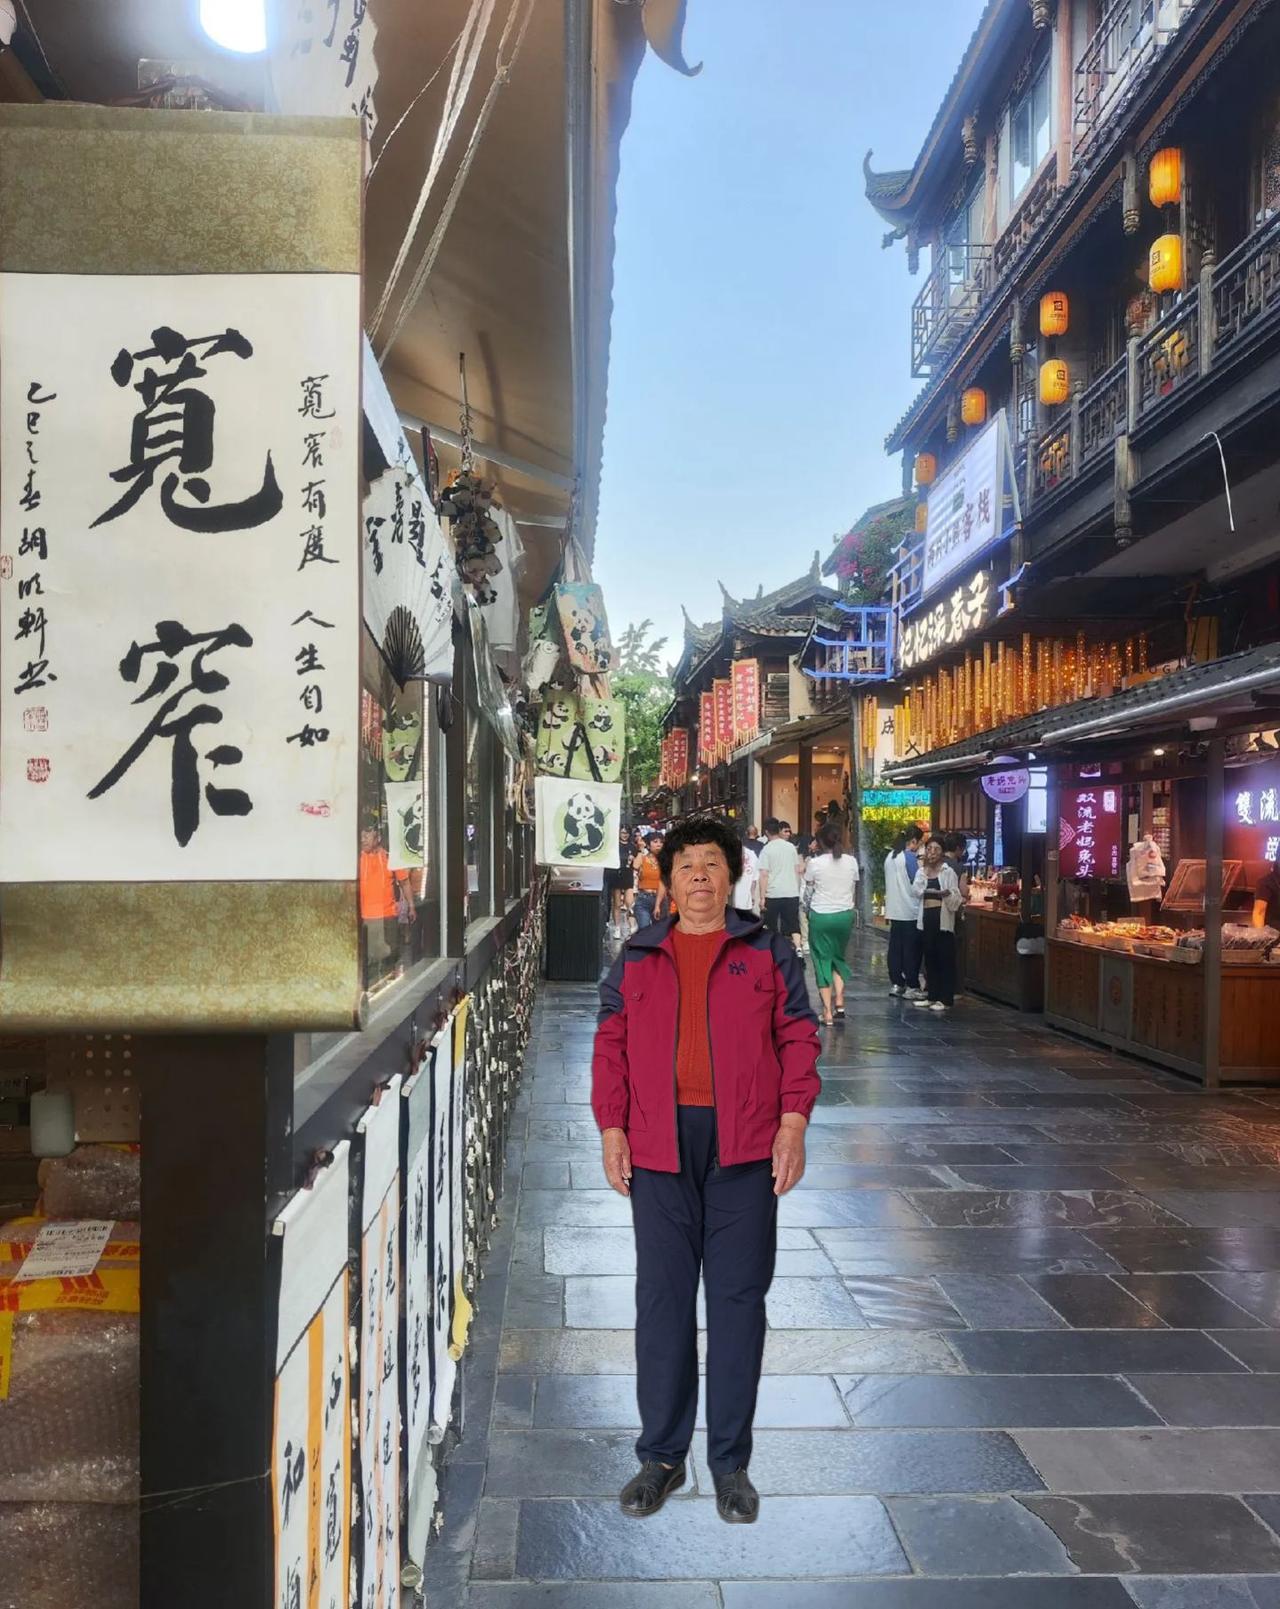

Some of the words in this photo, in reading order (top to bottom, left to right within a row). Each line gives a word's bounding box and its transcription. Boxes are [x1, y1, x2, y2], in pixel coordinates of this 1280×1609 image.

[1075, 792, 1097, 878] 双流老妈兔头
